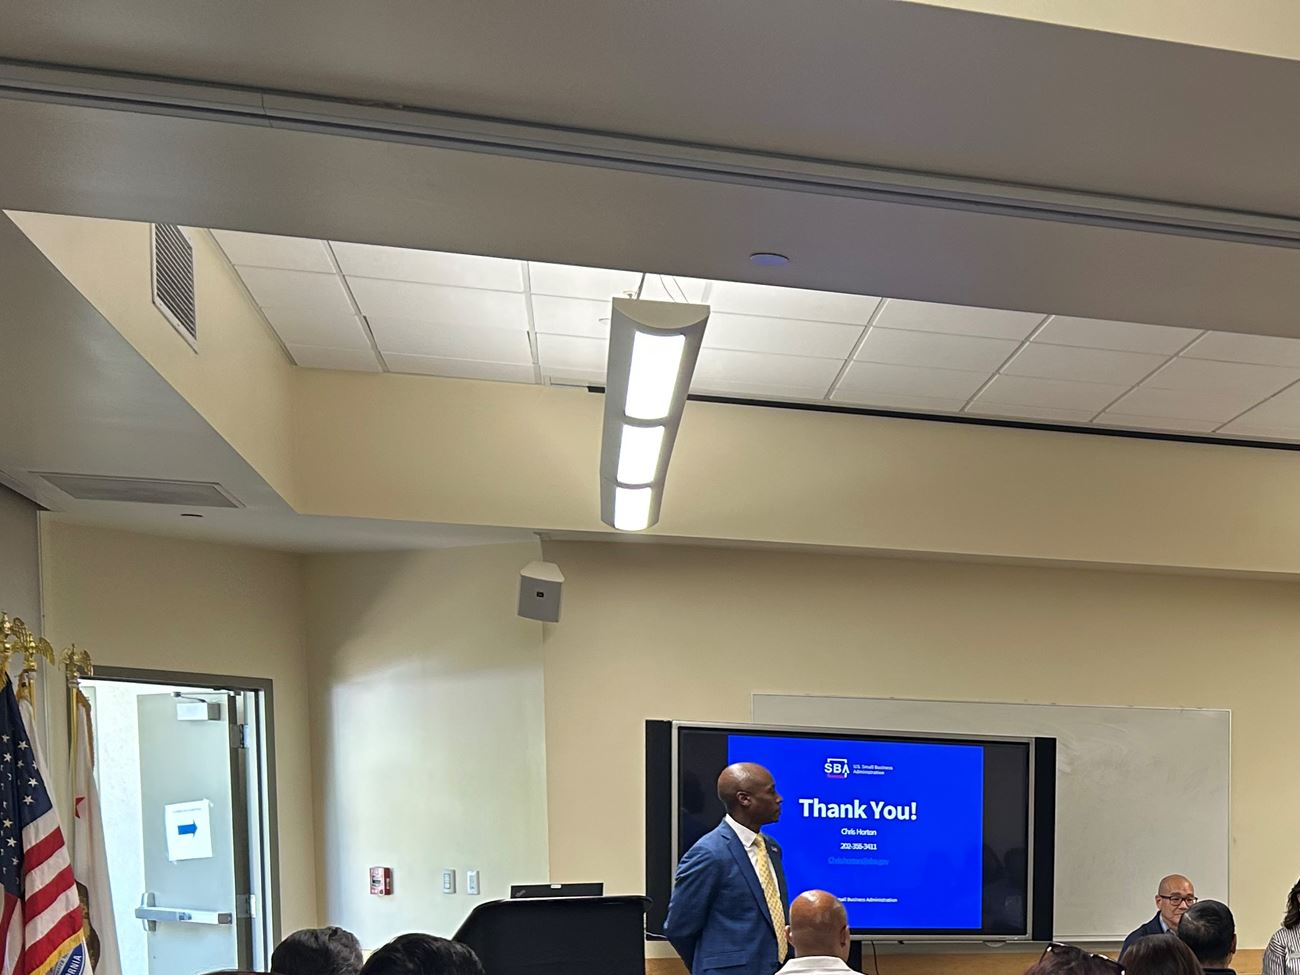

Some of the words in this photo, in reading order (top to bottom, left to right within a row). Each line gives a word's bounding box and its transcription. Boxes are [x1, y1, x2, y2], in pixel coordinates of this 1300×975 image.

[798, 798, 867, 818] Thank
[870, 801, 917, 820] You!
[856, 828, 877, 836] Horton
